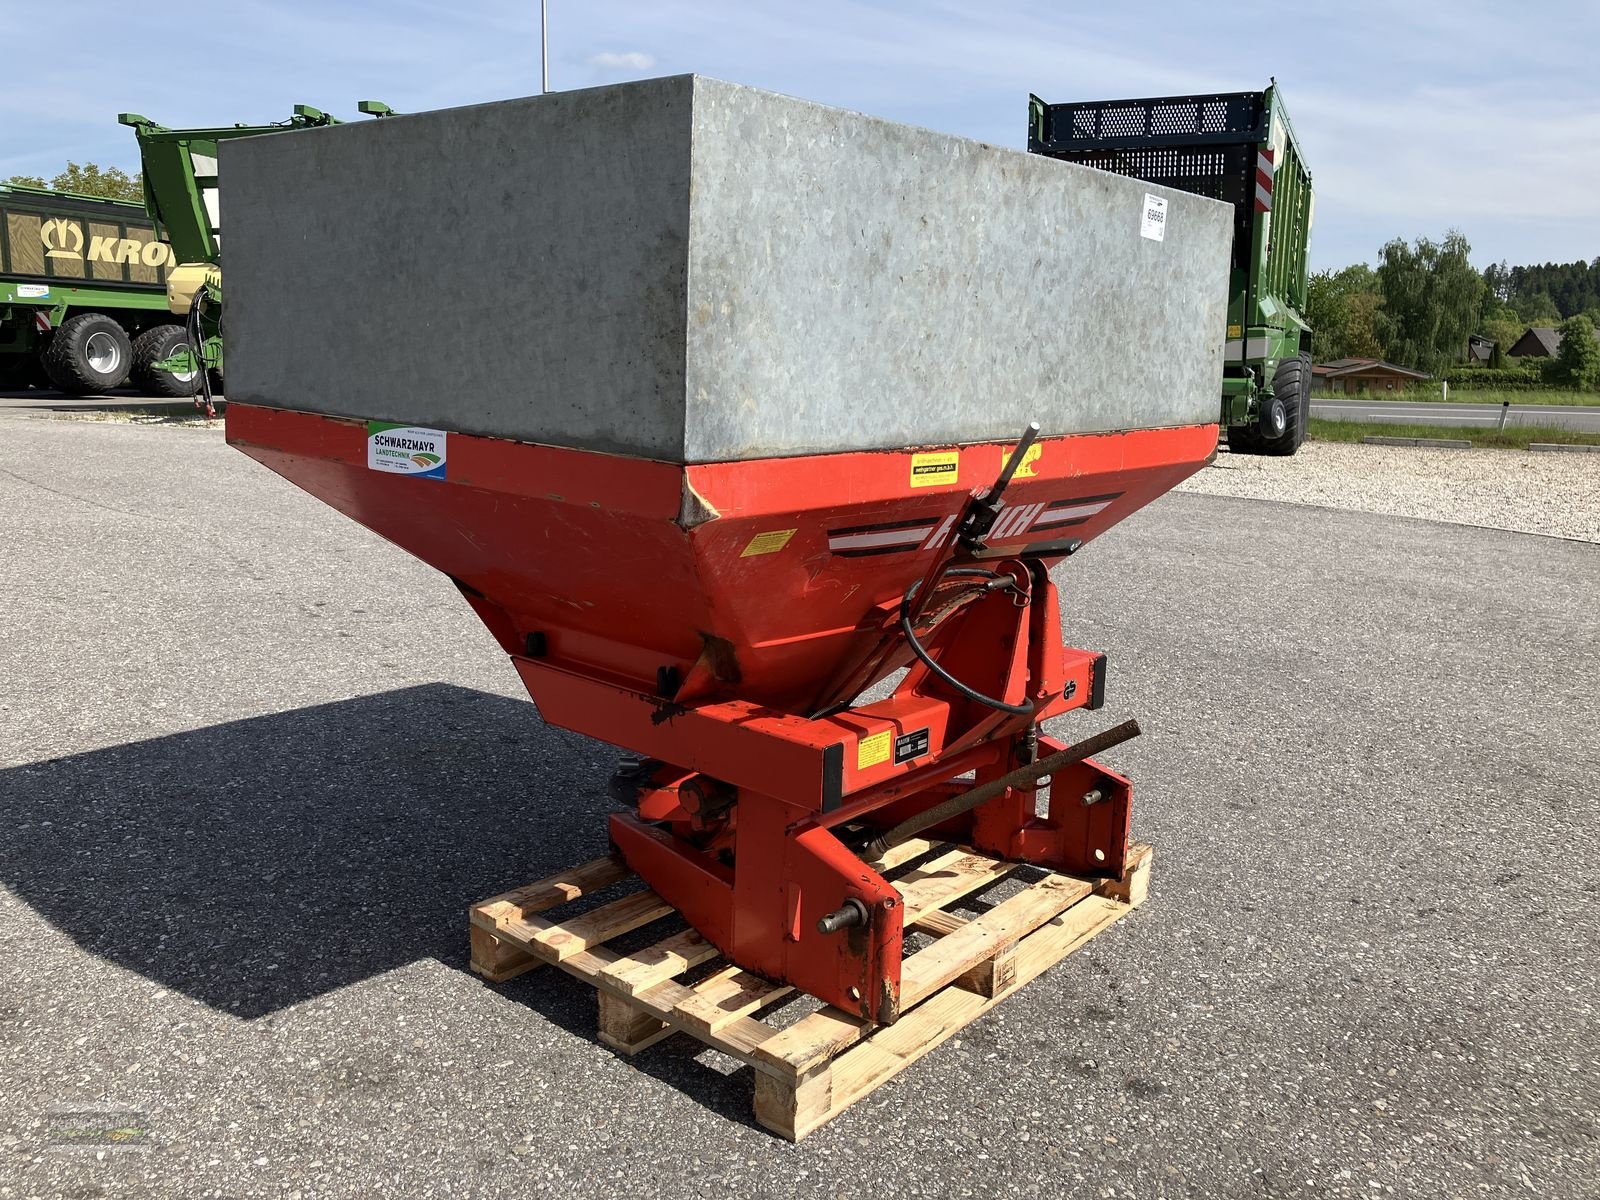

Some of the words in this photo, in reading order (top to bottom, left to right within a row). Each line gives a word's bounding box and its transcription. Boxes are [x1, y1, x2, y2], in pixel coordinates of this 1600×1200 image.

[1147, 208, 1164, 223] 69668
[374, 434, 435, 453] SCHWARZMAYR
[375, 448, 411, 460] LANDTECHNIK
[923, 502, 1046, 551] RCH
